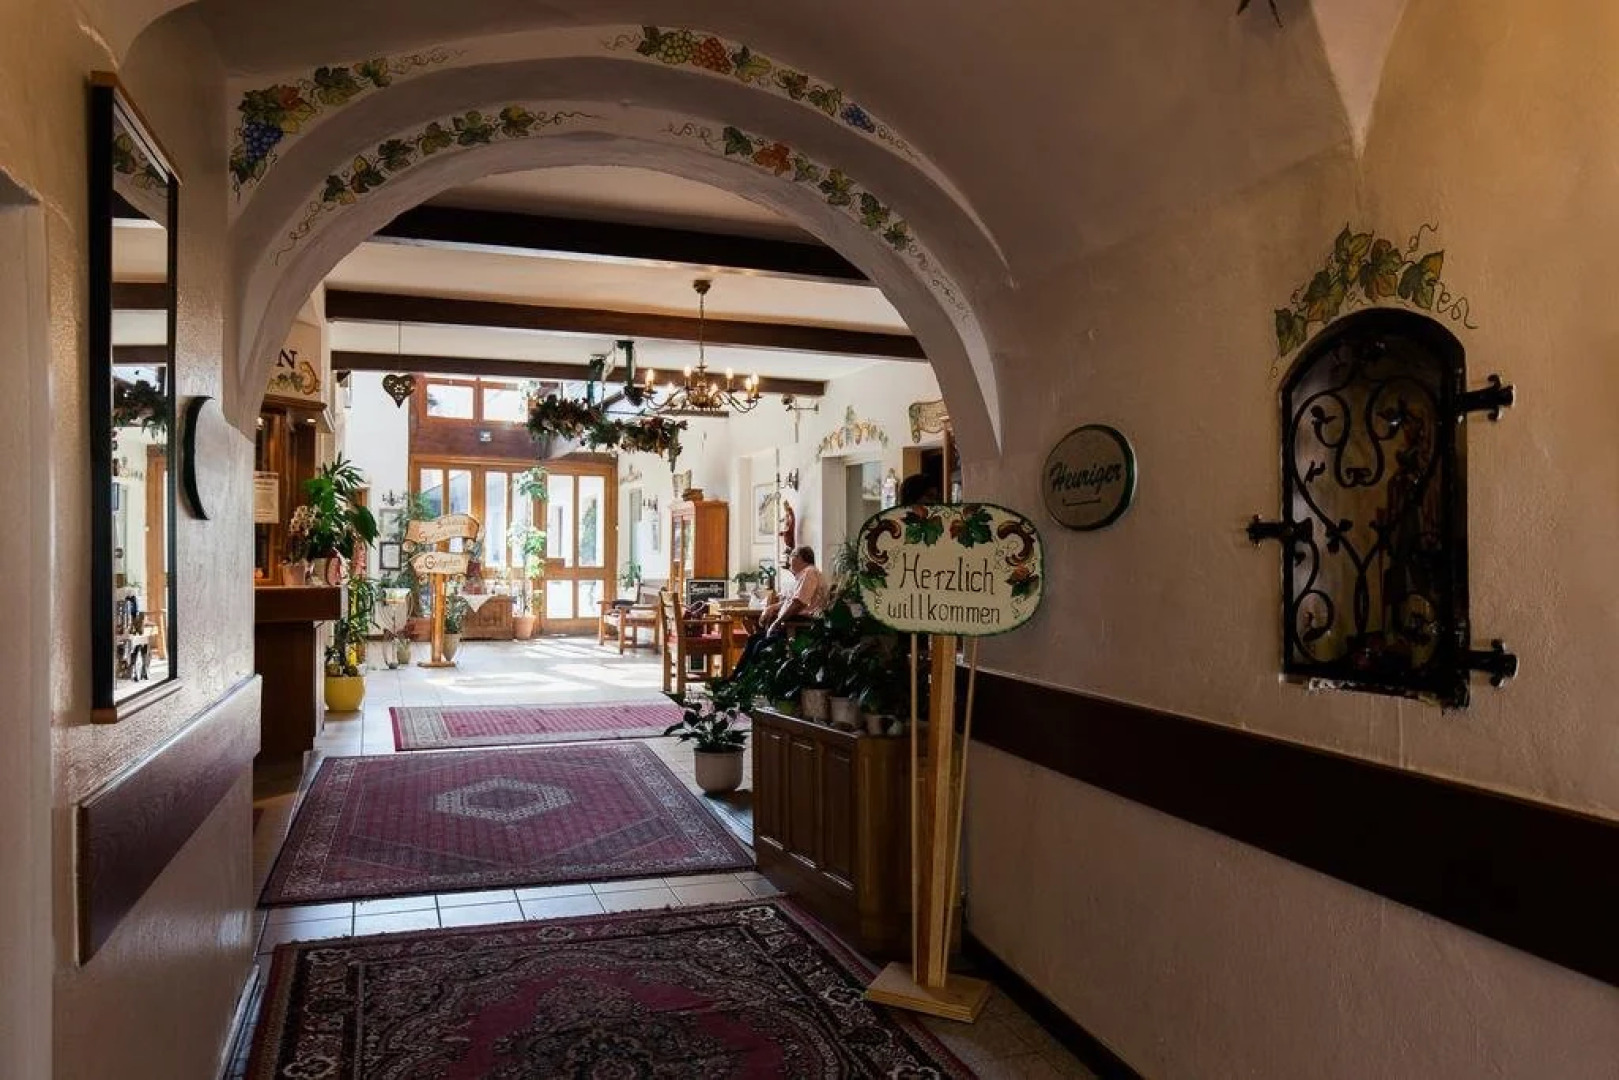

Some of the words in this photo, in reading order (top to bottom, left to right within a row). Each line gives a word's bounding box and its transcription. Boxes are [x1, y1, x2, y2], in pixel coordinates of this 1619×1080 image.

[276, 348, 298, 370] N
[1049, 461, 1122, 495] Heuriger
[900, 551, 995, 595] Herzlich
[886, 593, 1001, 624] willkommen
